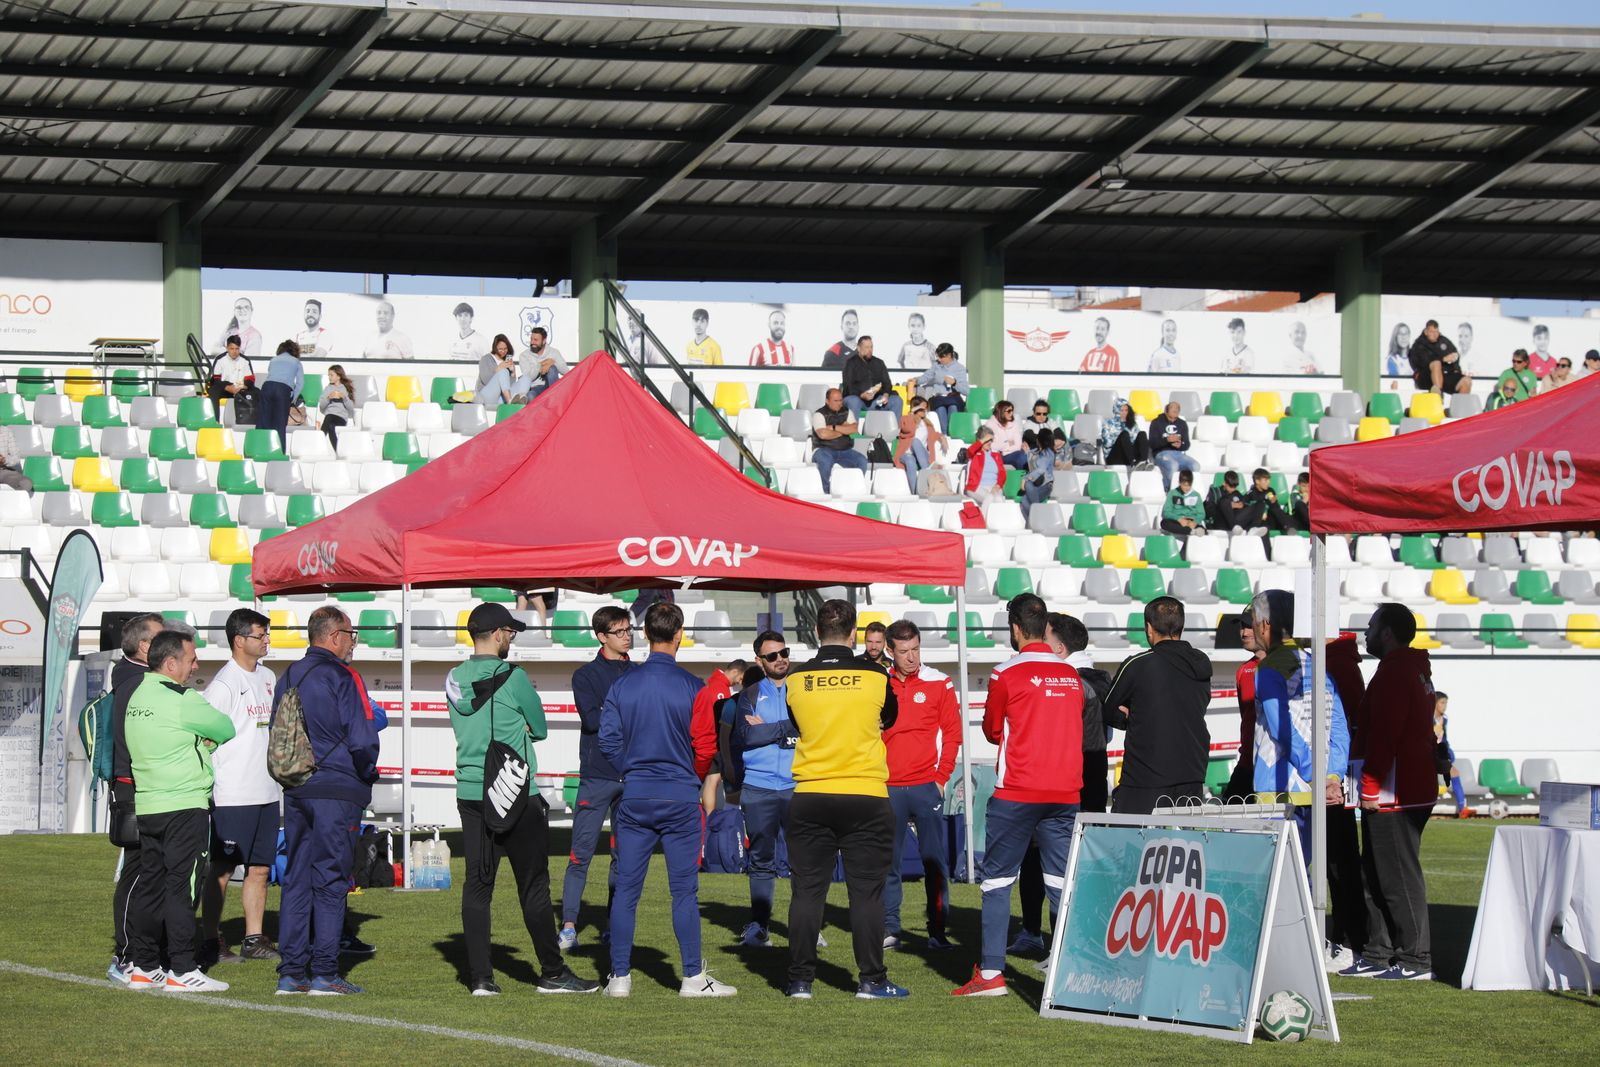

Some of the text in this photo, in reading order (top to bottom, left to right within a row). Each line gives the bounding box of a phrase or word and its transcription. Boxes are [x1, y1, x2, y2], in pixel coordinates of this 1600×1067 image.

[1452, 450, 1576, 513] COVAP
[617, 536, 759, 567] COVAP
[817, 675, 862, 687] ECCF
[487, 753, 529, 819] NIKE
[1140, 844, 1203, 890] COPA
[1106, 888, 1227, 963] COVAP
[1063, 972, 1096, 994] MUCHO
